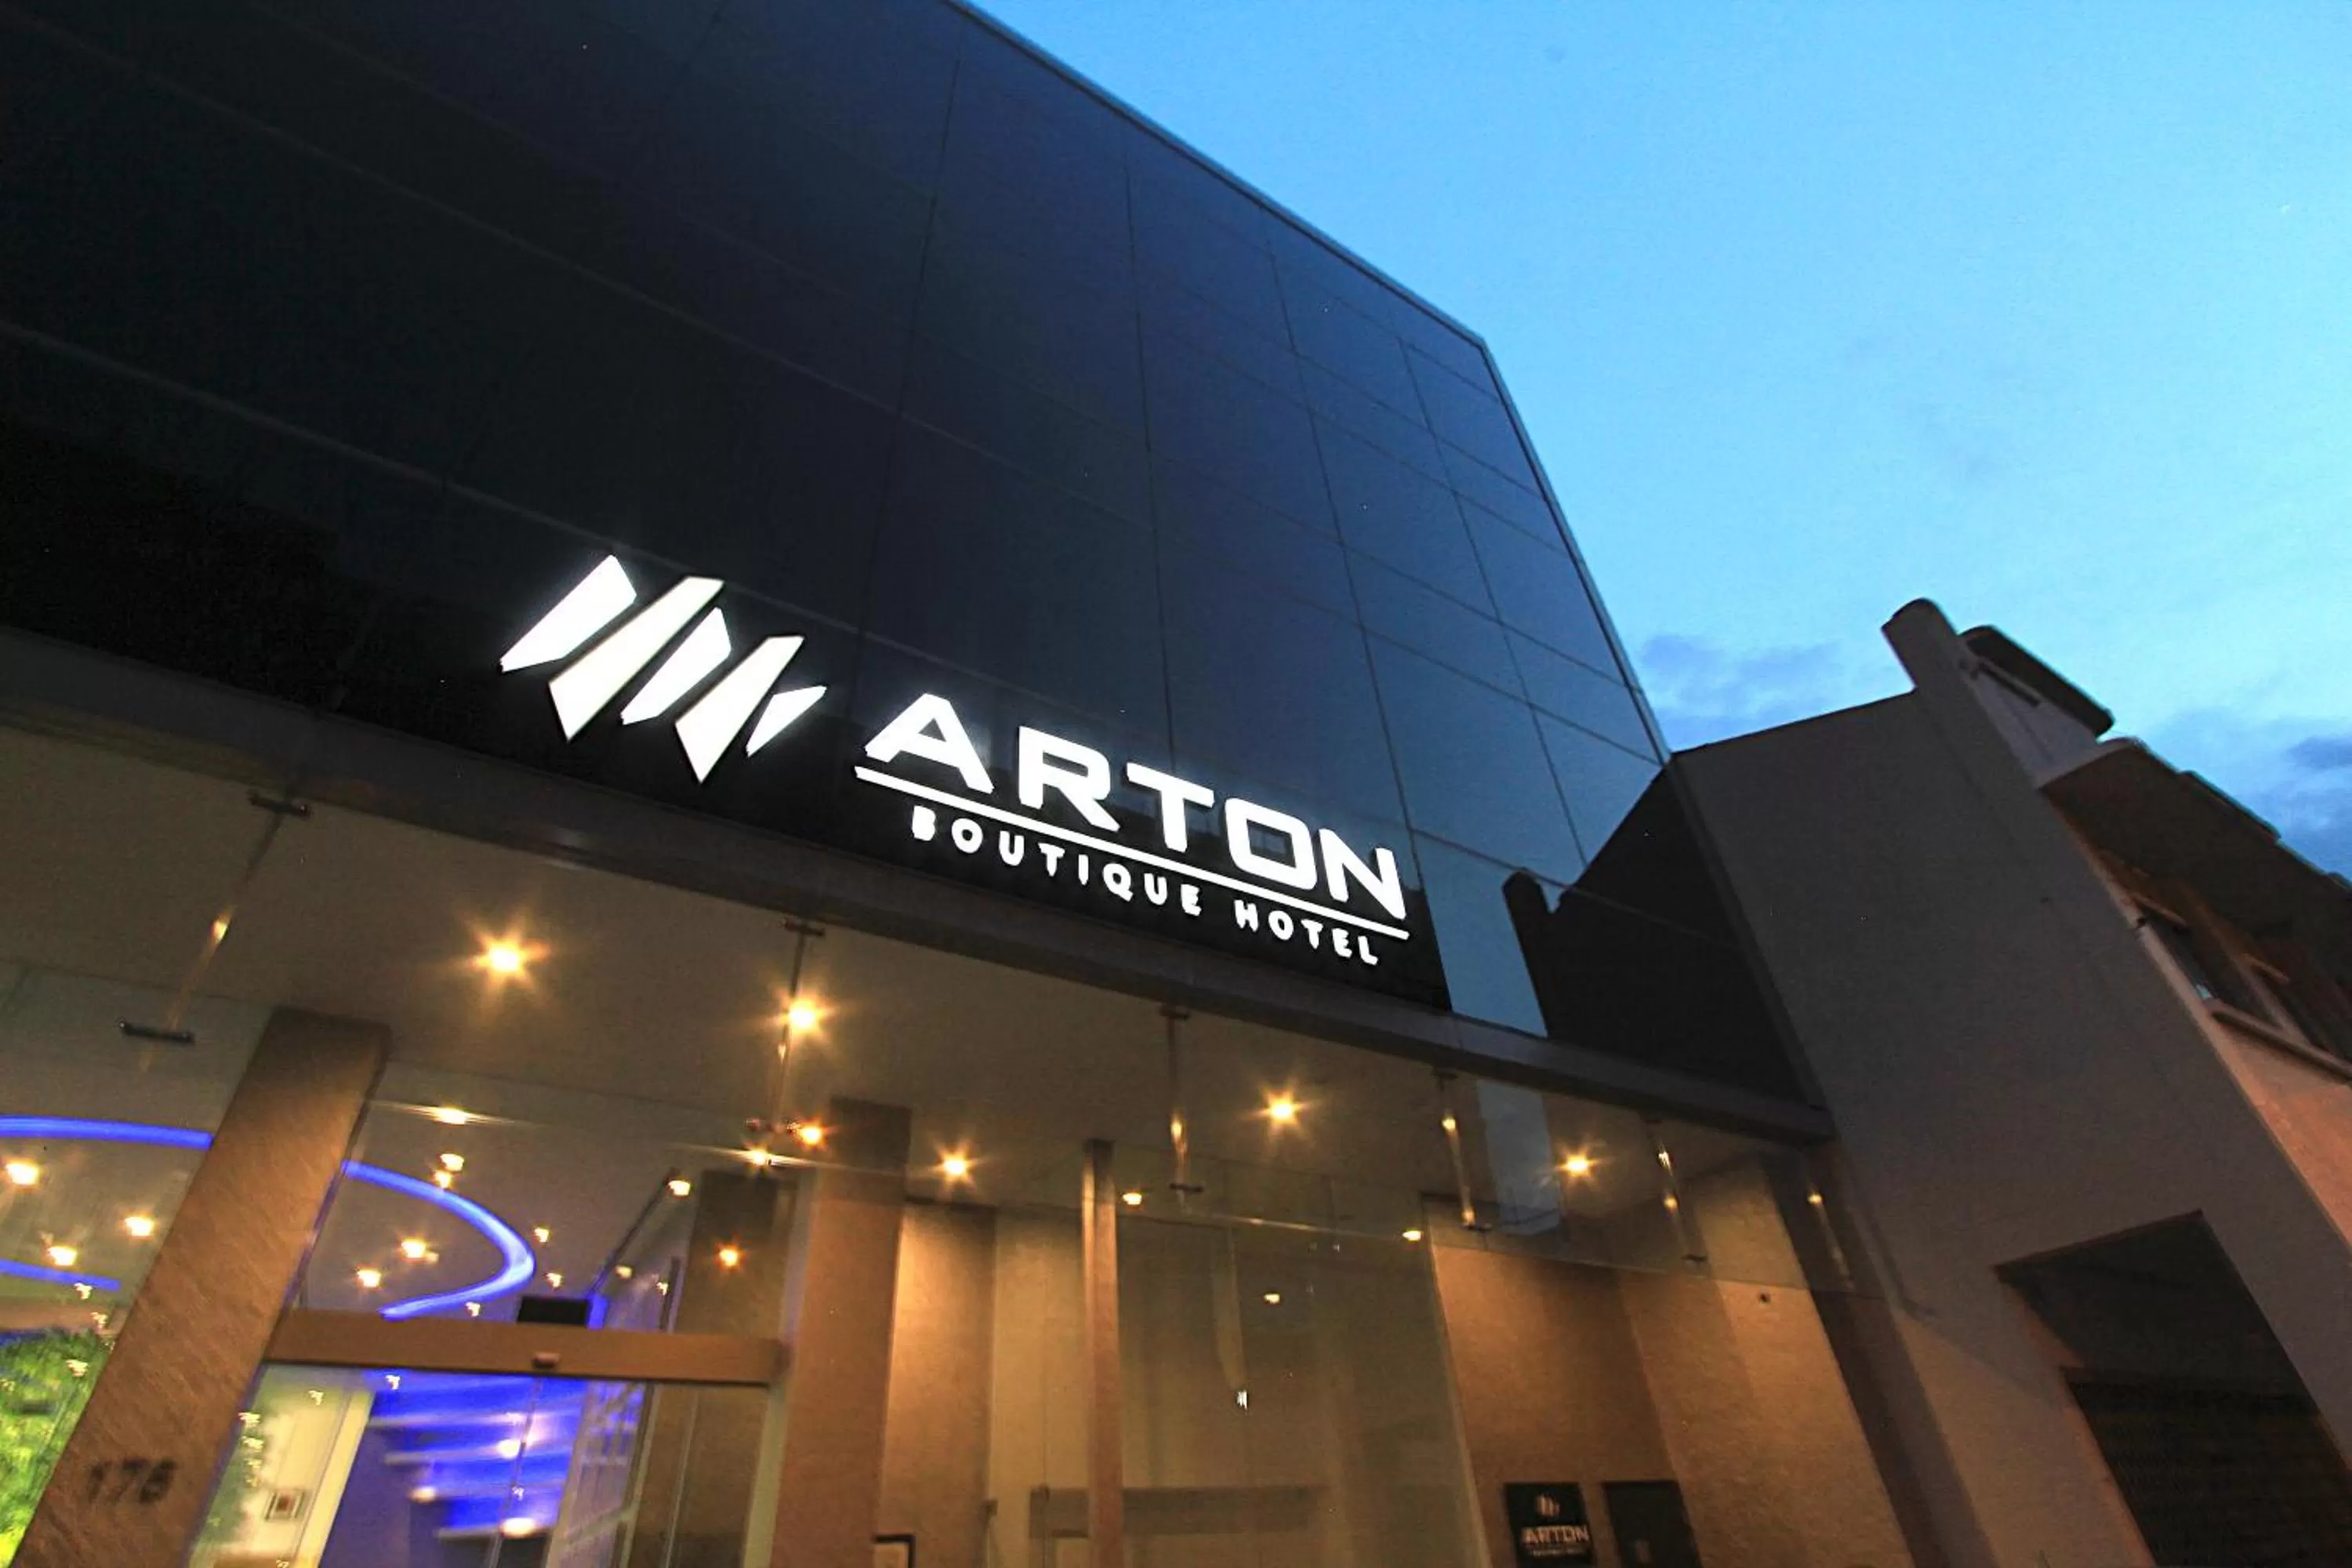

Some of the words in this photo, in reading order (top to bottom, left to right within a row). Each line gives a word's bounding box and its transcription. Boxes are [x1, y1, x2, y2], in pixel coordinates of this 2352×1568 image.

[864, 693, 1407, 920] ARTON
[910, 804, 1203, 916] BOUTIQUE
[1233, 899, 1379, 966] HOTEL
[1523, 1525, 1590, 1544] ARTON
